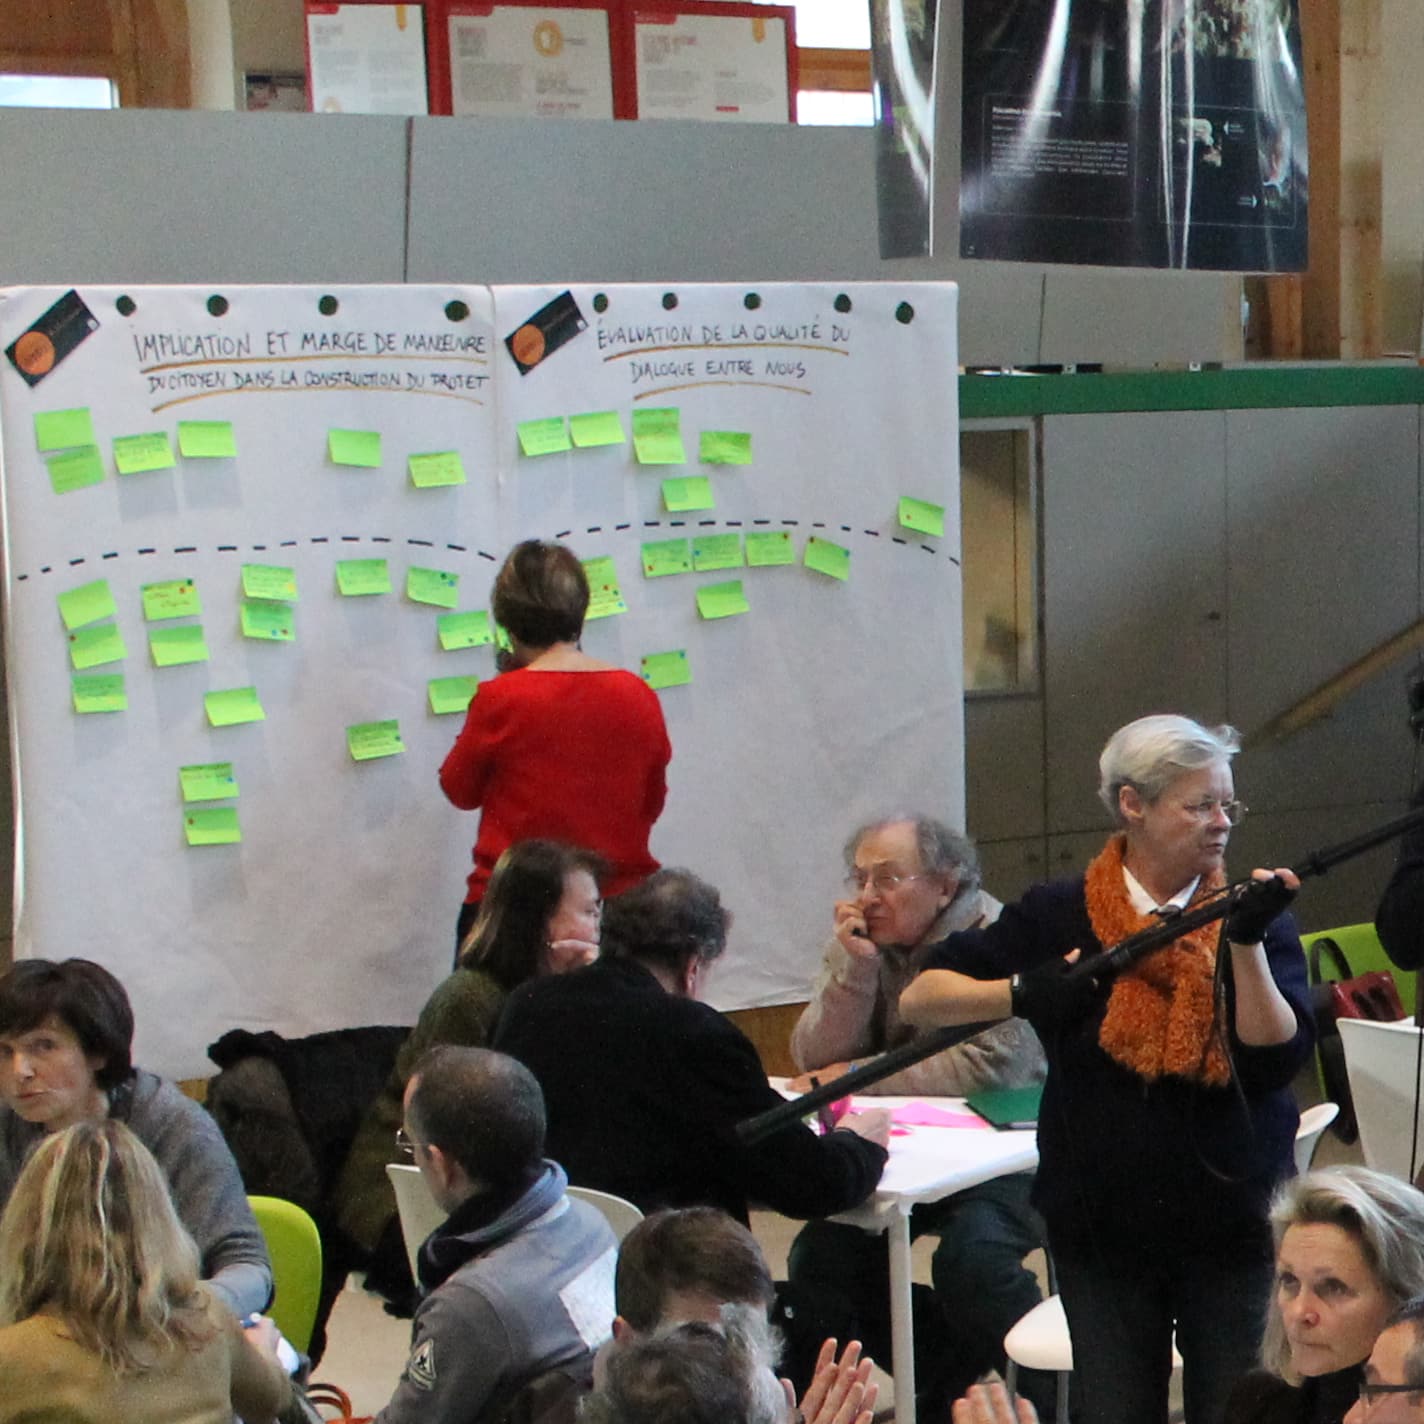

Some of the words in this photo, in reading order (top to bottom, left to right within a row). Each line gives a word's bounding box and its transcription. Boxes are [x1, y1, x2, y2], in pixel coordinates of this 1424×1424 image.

[702, 324, 722, 345] DE
[731, 324, 748, 340] LA
[753, 313, 822, 342] QUALITÉ
[832, 324, 850, 342] DU
[133, 331, 251, 362] IMPLICATION
[266, 331, 289, 356] ET
[301, 331, 368, 352] MARGE
[374, 331, 396, 352] DE
[148, 374, 168, 394] DU
[168, 371, 227, 391] CITOYEN
[233, 370, 276, 389] DANS
[281, 370, 298, 386] LA
[304, 370, 401, 388] CONSTRUCTION
[407, 372, 426, 388] DU
[629, 360, 696, 384] DIALOGUE
[706, 359, 754, 376] ENTRE
[765, 360, 806, 379] NOUS
